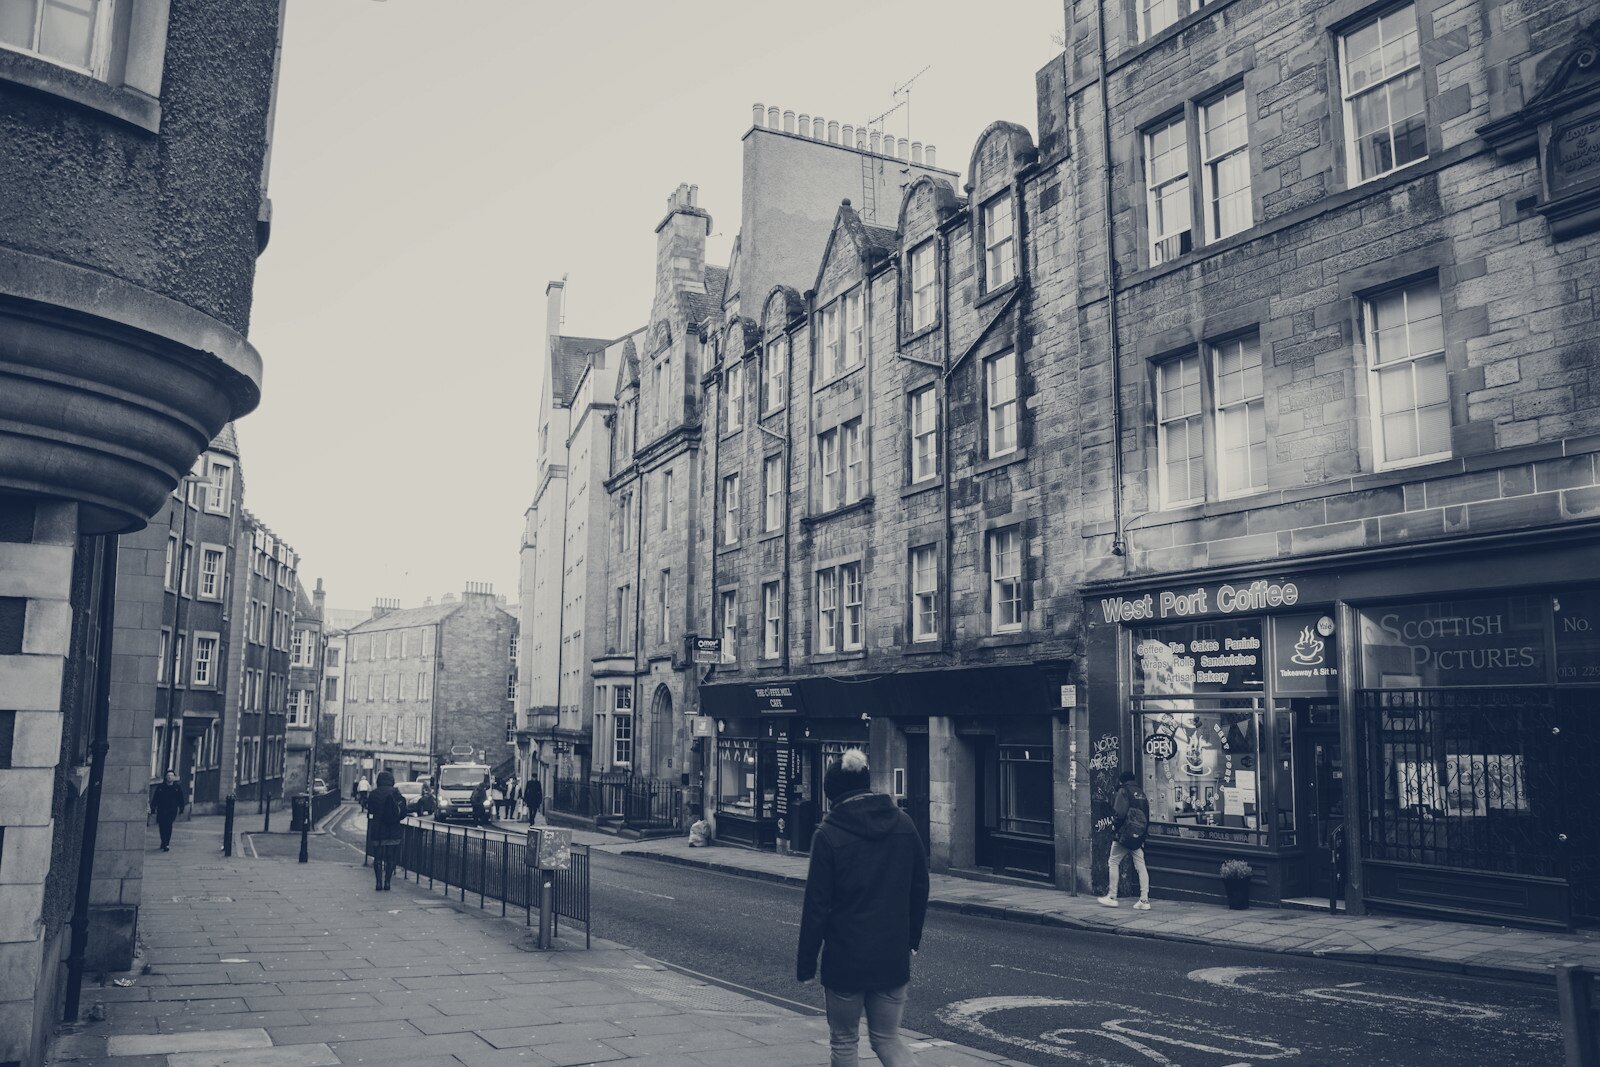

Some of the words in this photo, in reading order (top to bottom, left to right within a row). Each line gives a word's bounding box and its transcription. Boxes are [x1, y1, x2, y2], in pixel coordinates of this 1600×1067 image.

[1101, 594, 1154, 623] West
[1159, 587, 1208, 618] Port
[1216, 581, 1298, 613] Coffee
[1137, 644, 1164, 656] Coffee
[1169, 642, 1185, 654] Tea
[1190, 640, 1219, 652] Cakes
[1224, 637, 1260, 651] Paninis
[1141, 658, 1168, 671] Wraps
[1172, 656, 1195, 668] Rolls
[1200, 654, 1257, 668] Sandwiches
[1165, 672, 1195, 684] Artisan
[1196, 671, 1230, 685] Bakery
[1280, 669, 1313, 678] Takeaway
[1313, 668, 1319, 676] &
[1319, 668, 1330, 676] Sit
[1557, 666, 1577, 678] 0131
[1146, 741, 1172, 755] OPEN
[1209, 831, 1230, 841] ROLLS
[1233, 833, 1250, 843] WRA
